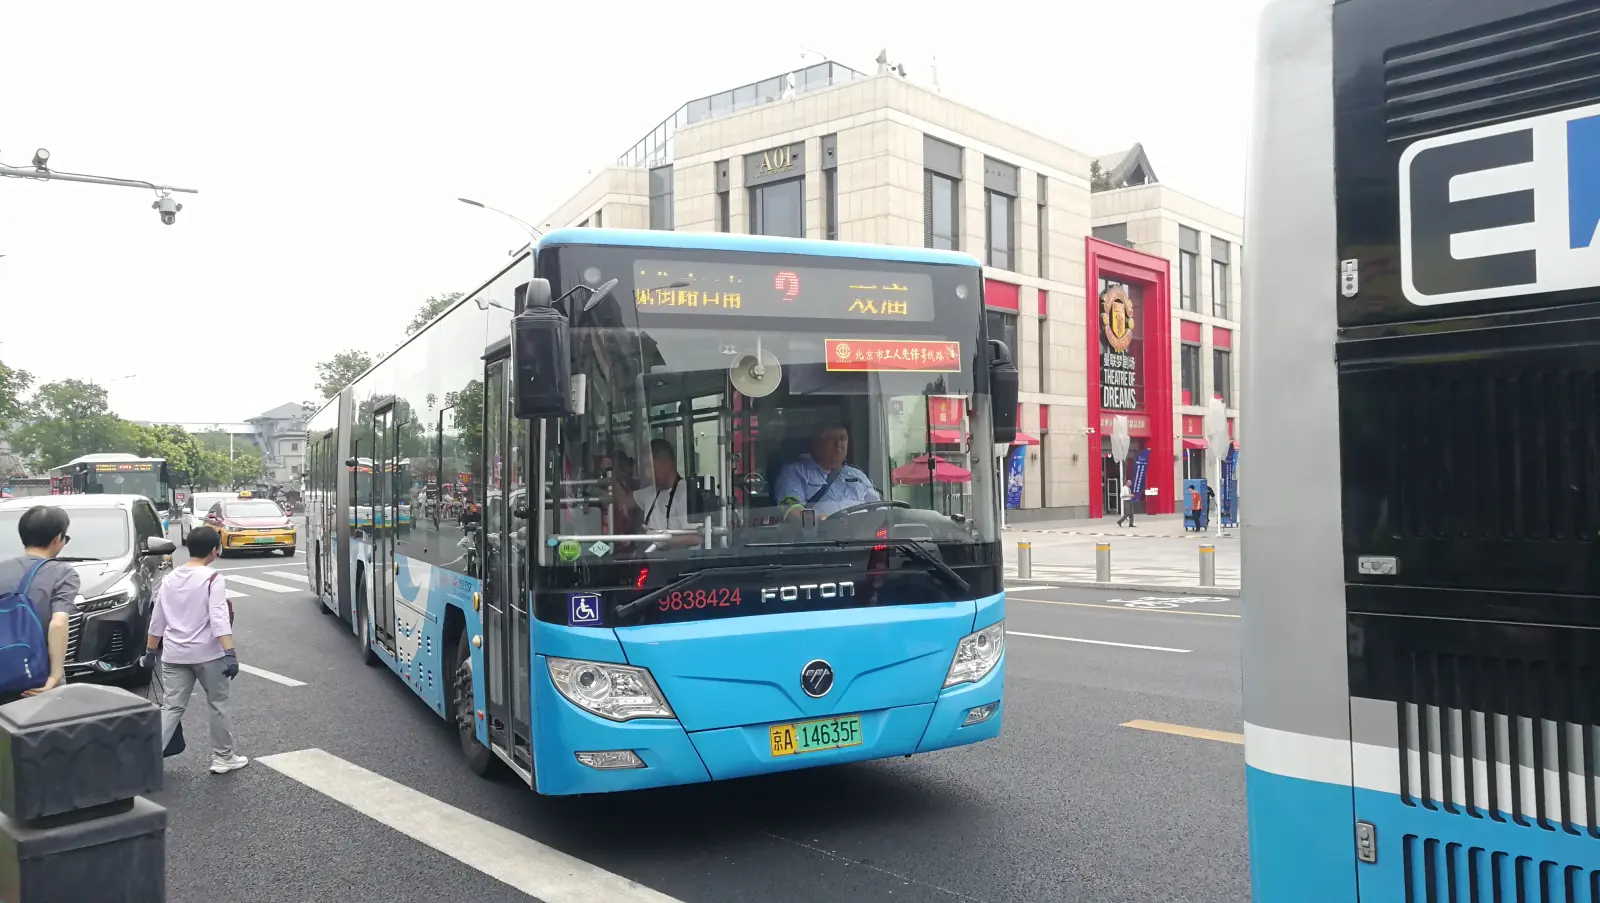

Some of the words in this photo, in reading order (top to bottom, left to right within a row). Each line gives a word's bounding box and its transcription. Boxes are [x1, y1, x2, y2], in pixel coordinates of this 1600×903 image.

[855, 347, 945, 364] 北京市工人先锋号线路
[1104, 352, 1136, 370] 曼联梦剧场
[1103, 369, 1128, 386] THEATRE
[1128, 371, 1136, 387] OF
[1103, 386, 1136, 409] DREAMS
[658, 586, 742, 612] 9838424
